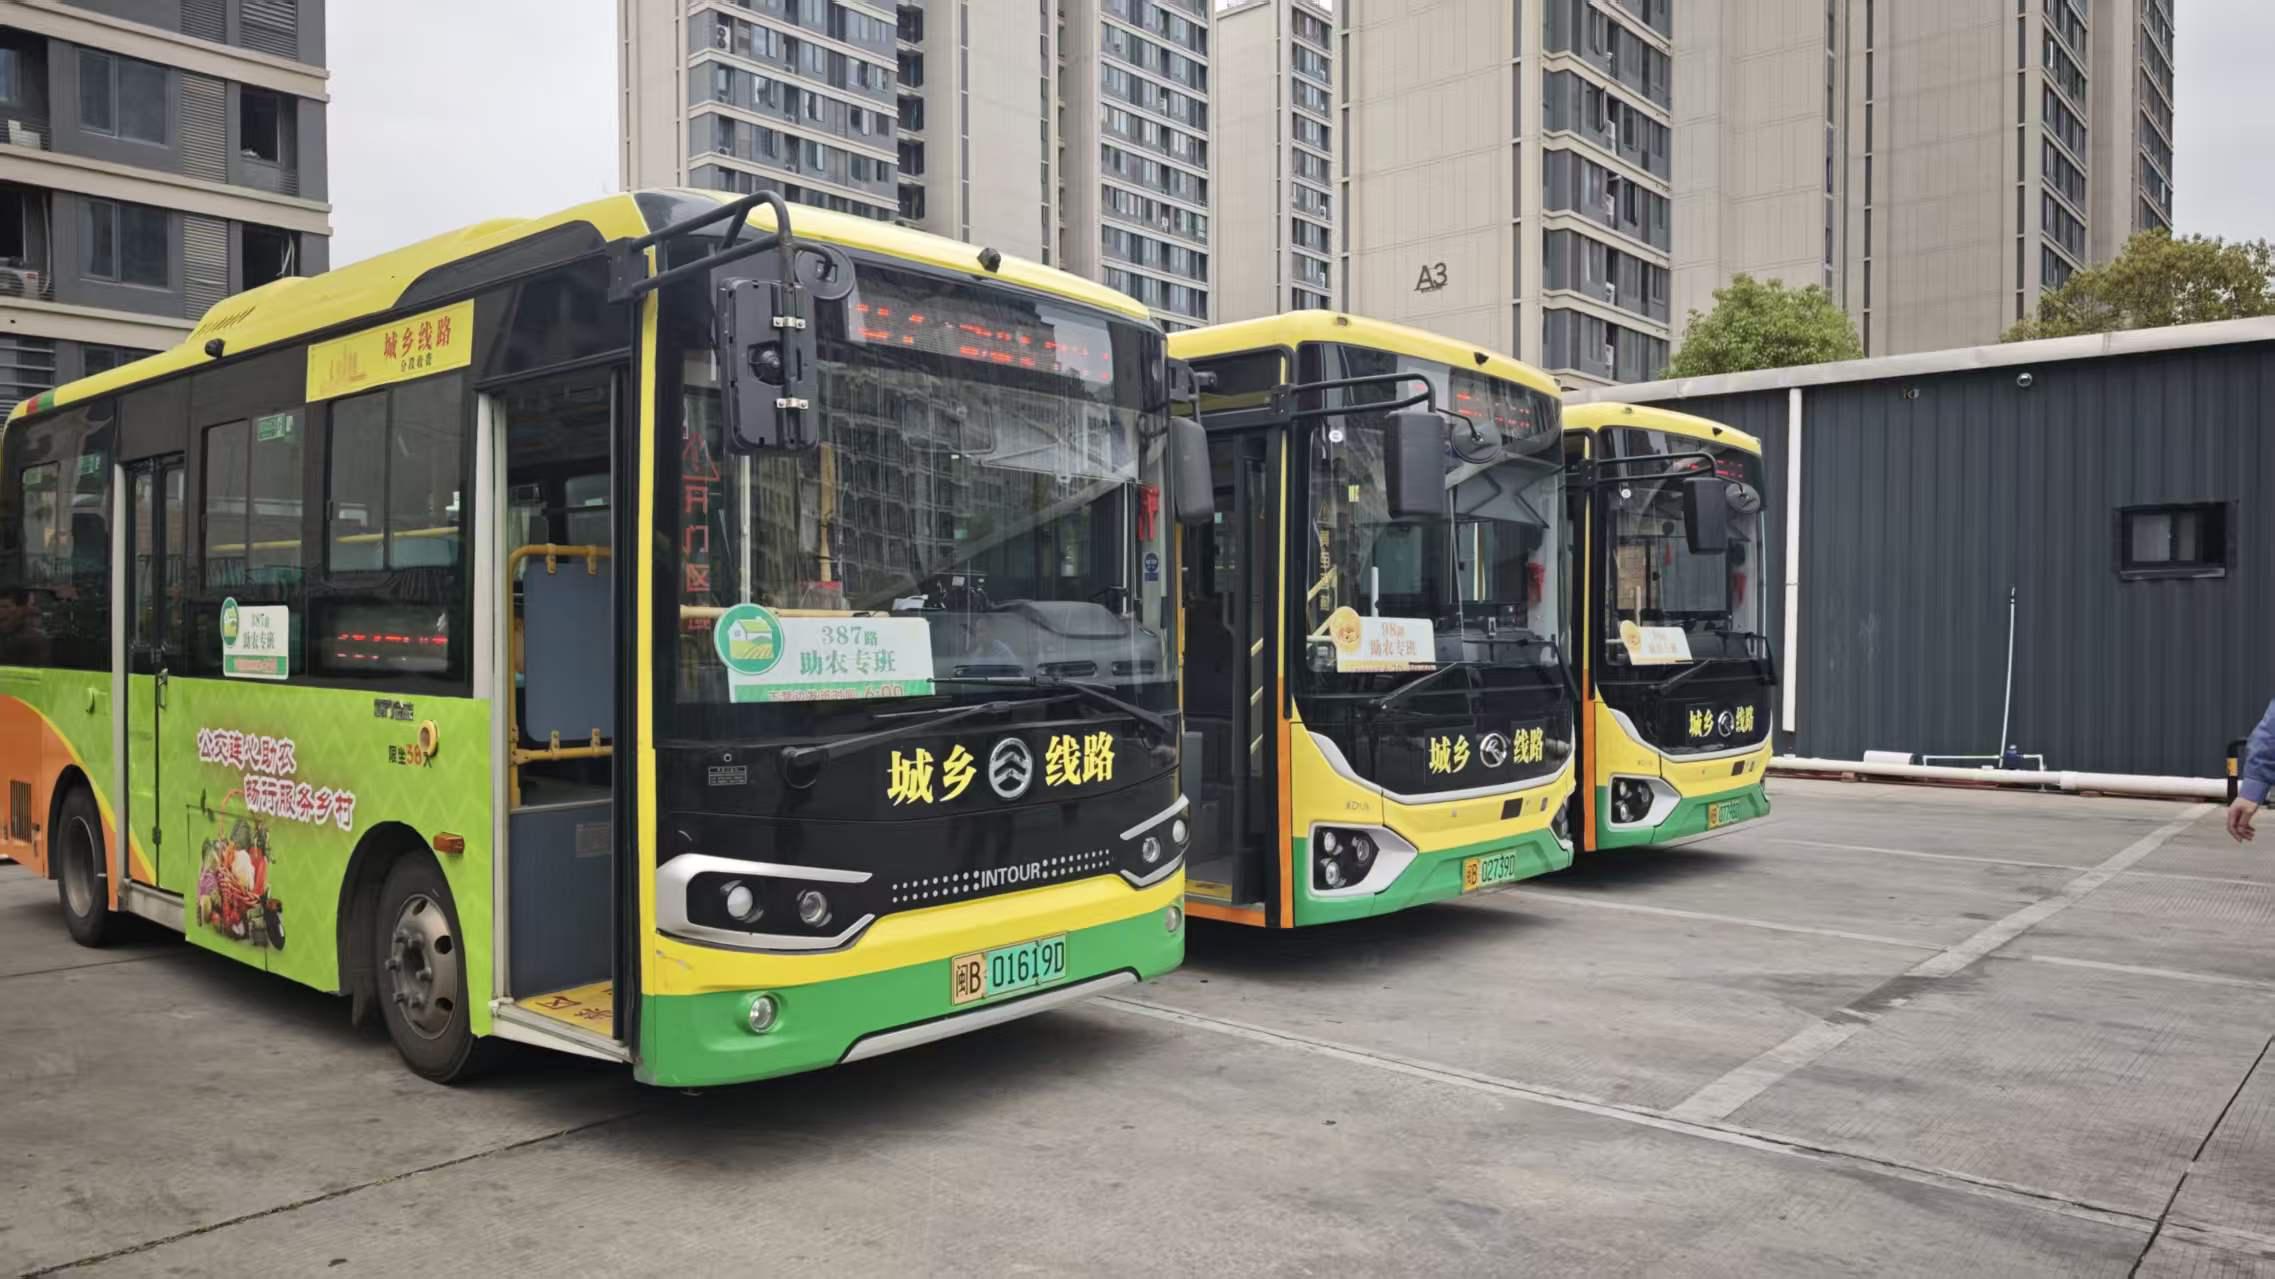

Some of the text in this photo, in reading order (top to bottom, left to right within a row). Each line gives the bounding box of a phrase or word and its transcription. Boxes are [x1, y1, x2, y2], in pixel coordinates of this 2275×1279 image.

[1415, 262, 1448, 291] A3
[384, 315, 452, 360] 城乡线路
[820, 624, 879, 647] 387路
[799, 649, 897, 677] 助农专班
[1687, 704, 1754, 737] 城乡 线路
[198, 728, 297, 776] 公交连心助农
[887, 731, 1116, 807] 城乡 线路
[1428, 726, 1544, 774] 城乡 线路
[244, 773, 355, 832] 畅行服务乡村
[981, 862, 1041, 889] INTOUR
[991, 941, 1065, 988] 01619D
